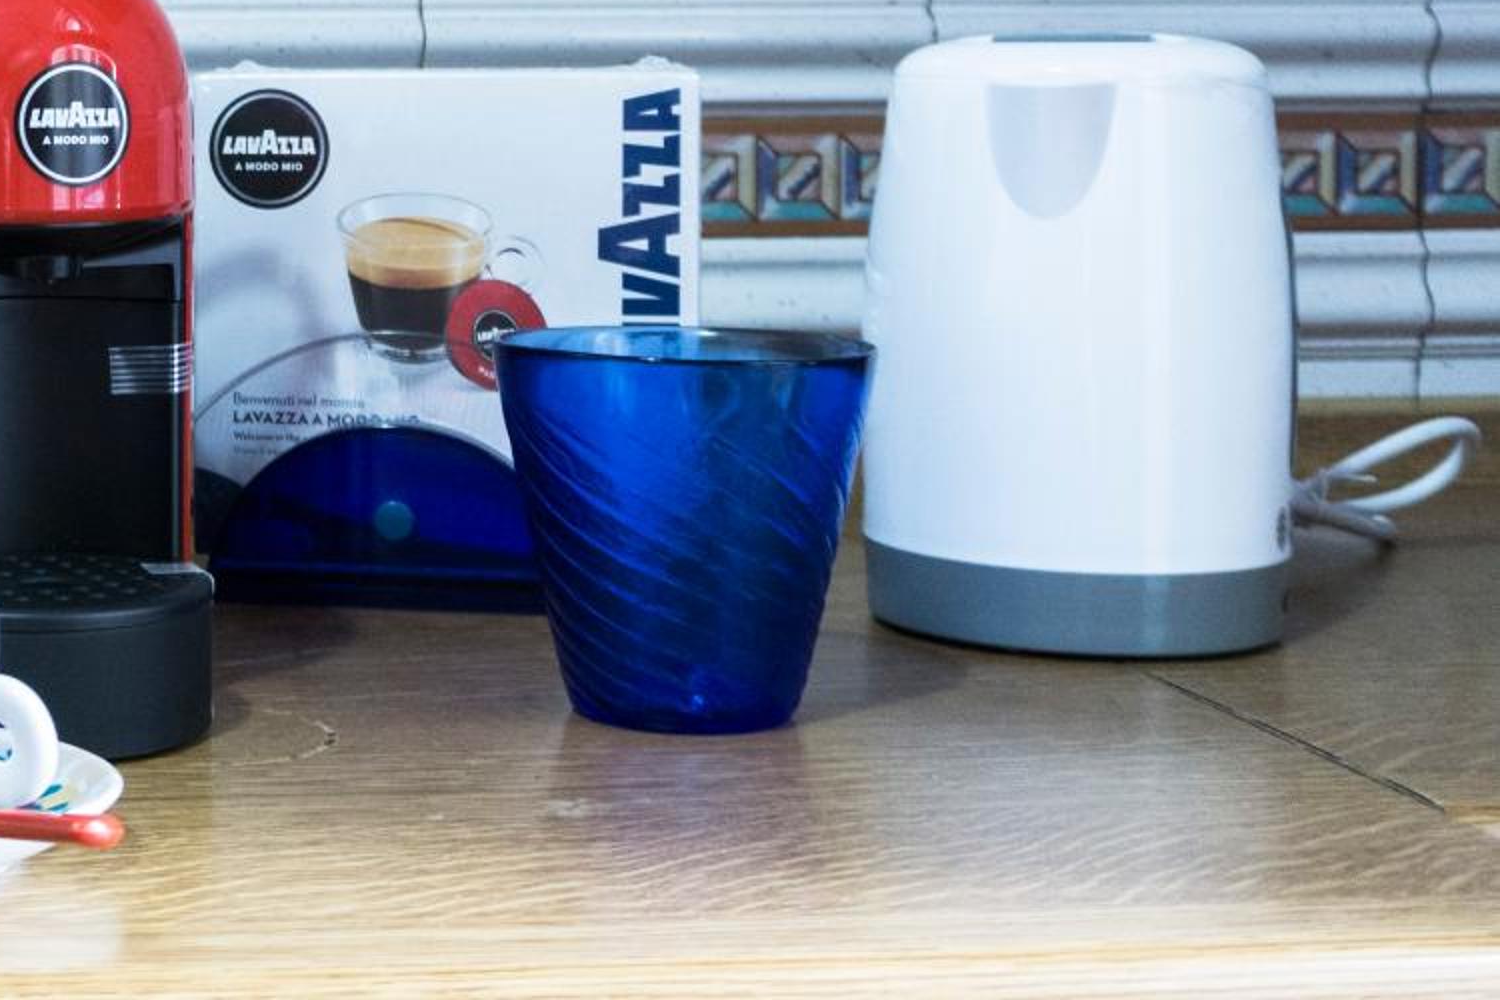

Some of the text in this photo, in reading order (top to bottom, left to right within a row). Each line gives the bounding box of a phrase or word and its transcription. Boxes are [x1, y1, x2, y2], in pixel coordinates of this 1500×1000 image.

[29, 101, 120, 128] LAVAZZA
[43, 134, 109, 145] A MODO MIO
[222, 129, 317, 155] LAVAZZA
[236, 161, 303, 172] A MODO MIO
[598, 87, 681, 326] VAZZA
[233, 410, 308, 425] LAVAZZA
[312, 412, 323, 425] A
